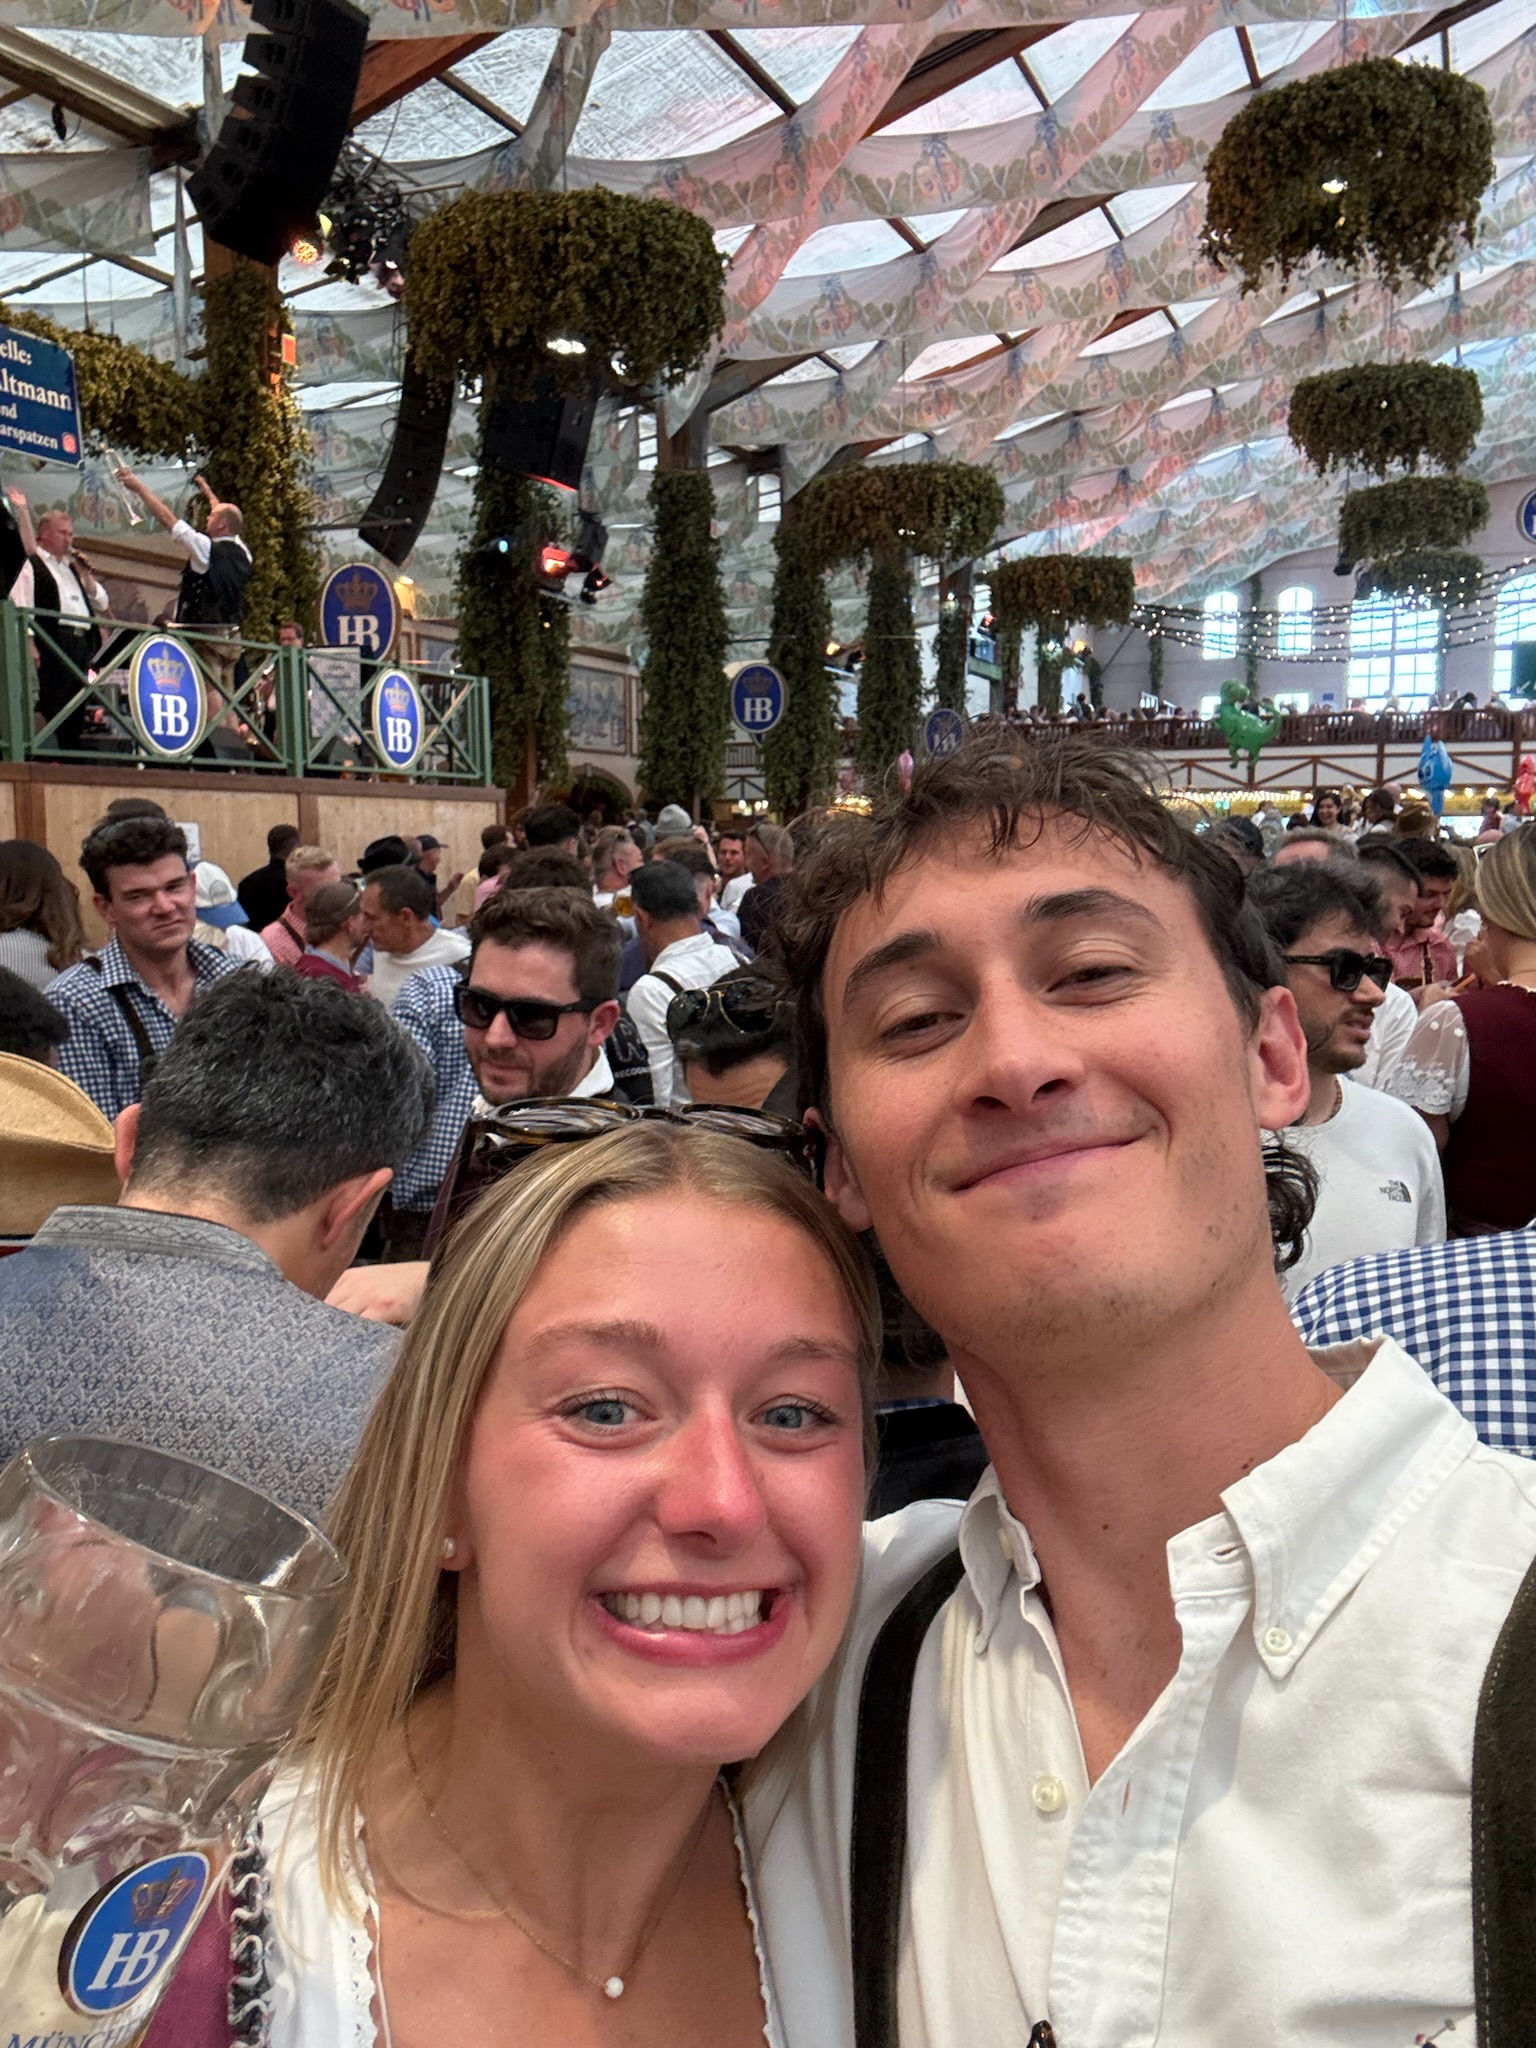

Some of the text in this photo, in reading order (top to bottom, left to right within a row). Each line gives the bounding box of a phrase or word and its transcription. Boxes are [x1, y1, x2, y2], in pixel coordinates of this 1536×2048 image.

[0, 368, 73, 411] ltmann
[337, 615, 380, 652] HB
[150, 693, 189, 737] HB
[743, 697, 773, 723] HB
[386, 717, 412, 753] HB
[87, 1928, 170, 1991] HB
